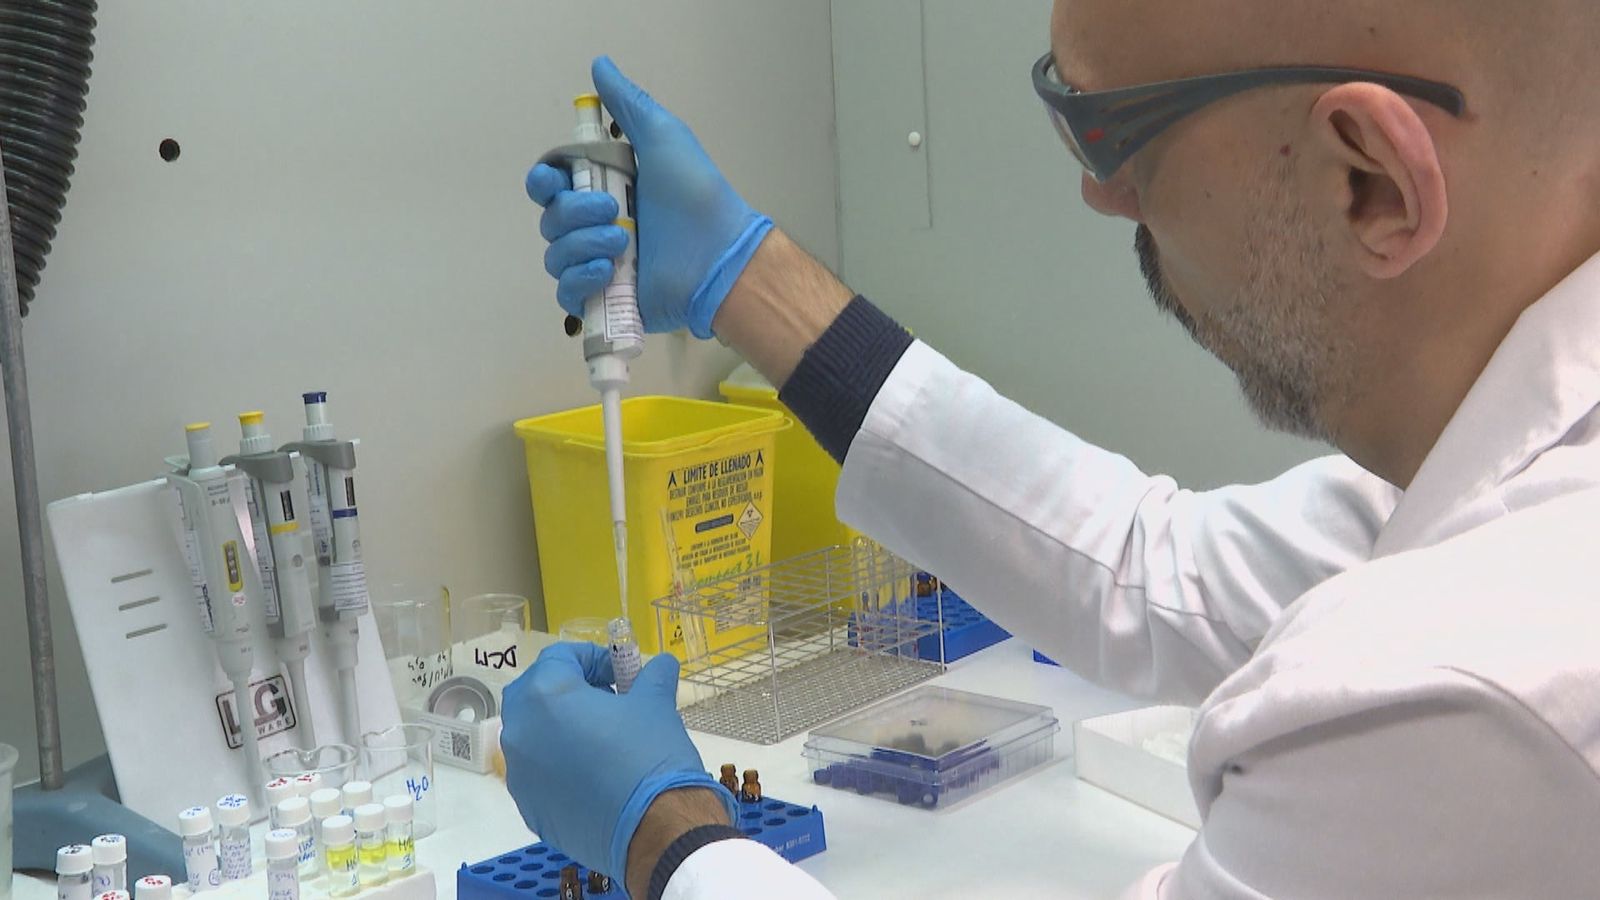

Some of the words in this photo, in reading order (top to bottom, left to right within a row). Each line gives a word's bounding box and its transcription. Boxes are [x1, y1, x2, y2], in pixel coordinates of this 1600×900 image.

[684, 465, 707, 484] LIMITE
[709, 462, 718, 478] DE
[720, 453, 751, 475] LLENADO
[475, 644, 517, 669] DCM
[406, 776, 429, 801] H2O
